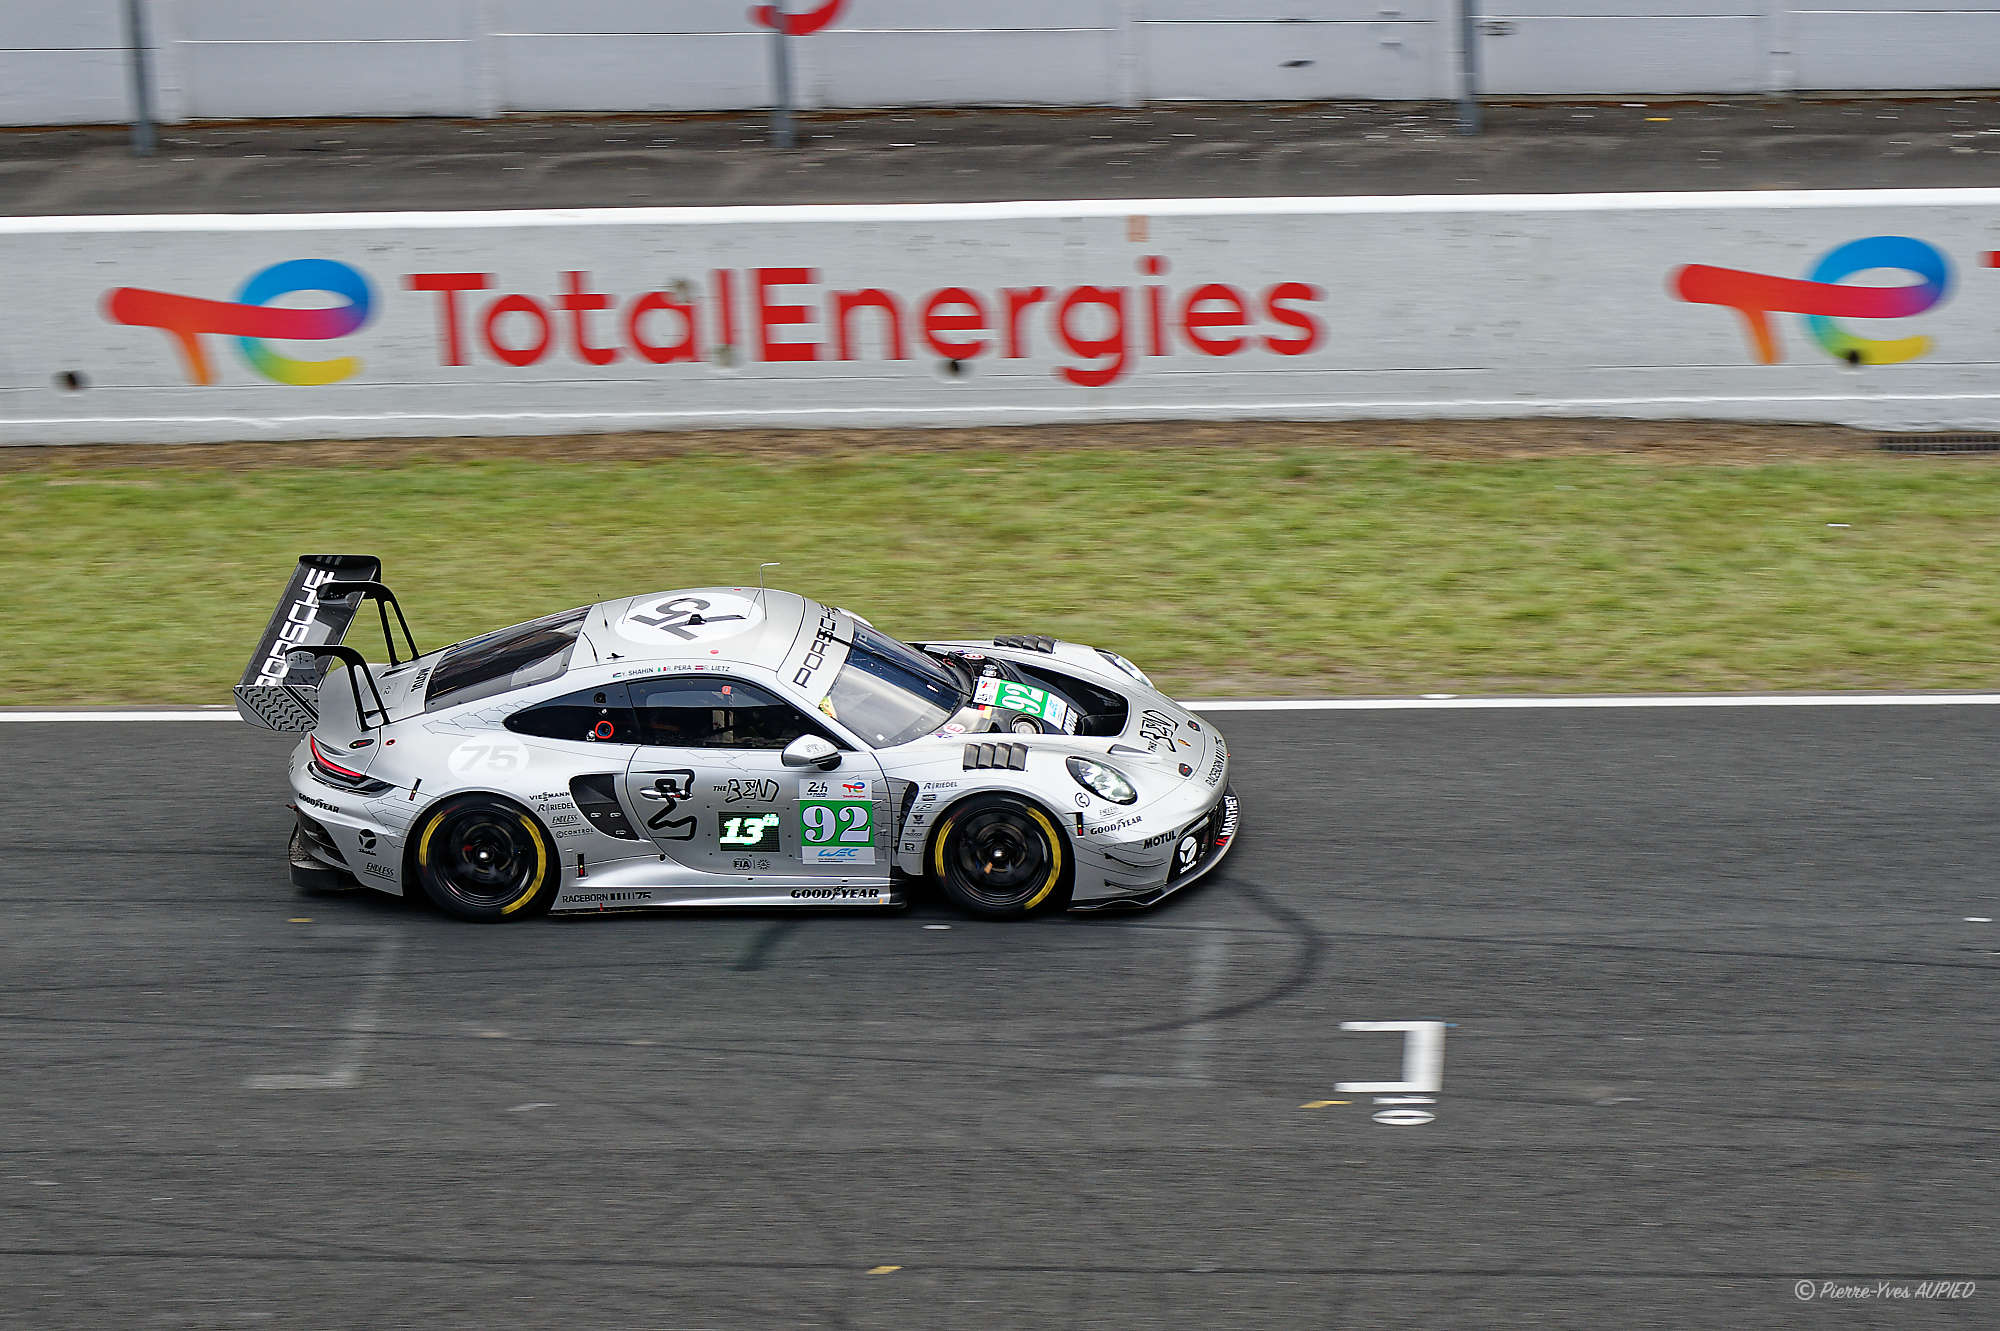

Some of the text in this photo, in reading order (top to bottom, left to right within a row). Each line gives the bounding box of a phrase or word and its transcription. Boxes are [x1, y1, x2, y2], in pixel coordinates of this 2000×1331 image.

[407, 256, 1326, 387] TotalEnergies
[629, 598, 746, 641] 75
[628, 667, 654, 676] SHAHIN
[711, 664, 731, 672] LIETZ
[1001, 683, 1045, 714] 92
[459, 745, 520, 773] 75
[725, 779, 780, 804] BEND
[935, 781, 958, 789] RIEDEL
[298, 792, 340, 814] GOODYEAR
[550, 802, 576, 811] RIEDEL
[801, 805, 871, 843] 92
[1222, 795, 1239, 837] MANTHEY
[564, 827, 594, 836] CONTROL
[1089, 815, 1143, 835] GOODYEAR
[1143, 830, 1177, 850] MOTUL
[817, 848, 860, 857] WEC
[366, 862, 395, 877] ENDLESS
[733, 859, 751, 869] FIA
[562, 893, 608, 903] RACEBORN
[790, 886, 880, 900] GOODYEAR
